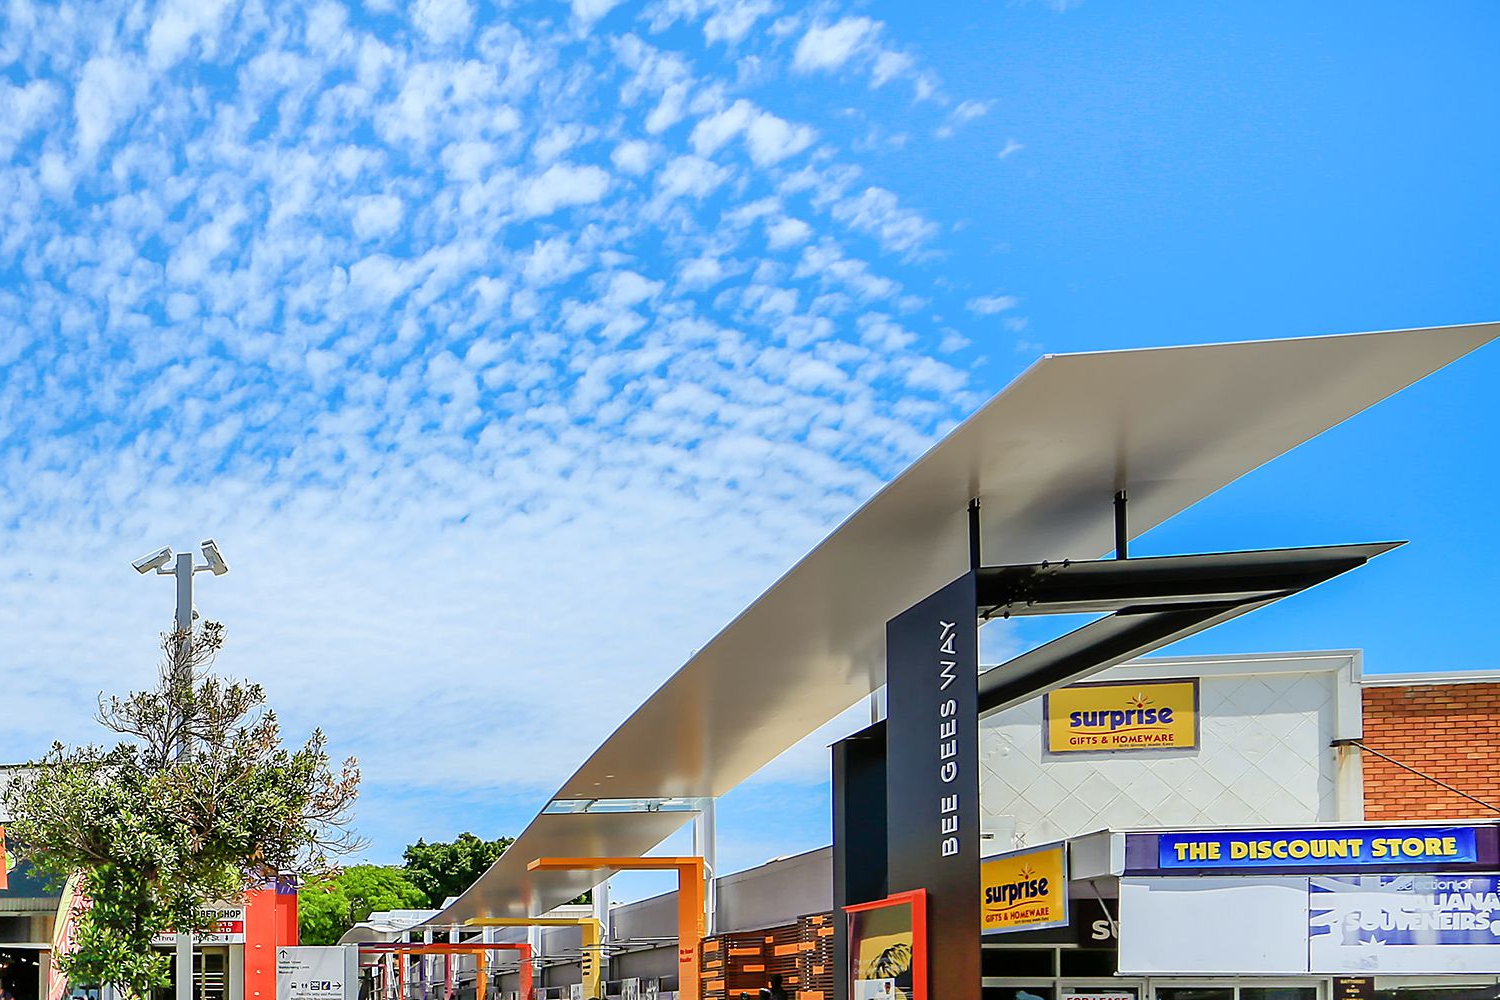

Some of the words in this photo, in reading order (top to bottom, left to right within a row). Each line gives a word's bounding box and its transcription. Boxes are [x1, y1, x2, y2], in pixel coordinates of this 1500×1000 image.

[939, 620, 956, 691] WAY
[1069, 707, 1174, 731] surprise
[940, 700, 957, 783] GEES
[1069, 736, 1097, 745] GIFTS
[1101, 736, 1108, 744] &
[1112, 733, 1174, 744] HOMEWARE
[941, 794, 959, 857] BEE
[1174, 842, 1221, 860] THE
[1229, 839, 1363, 859] DISCOUNT
[1371, 837, 1458, 857] STORE
[985, 877, 1049, 905] surprise
[985, 913, 1002, 923] GIFTS
[1003, 912, 1009, 921] &
[1010, 907, 1050, 920] HOMEWARE
